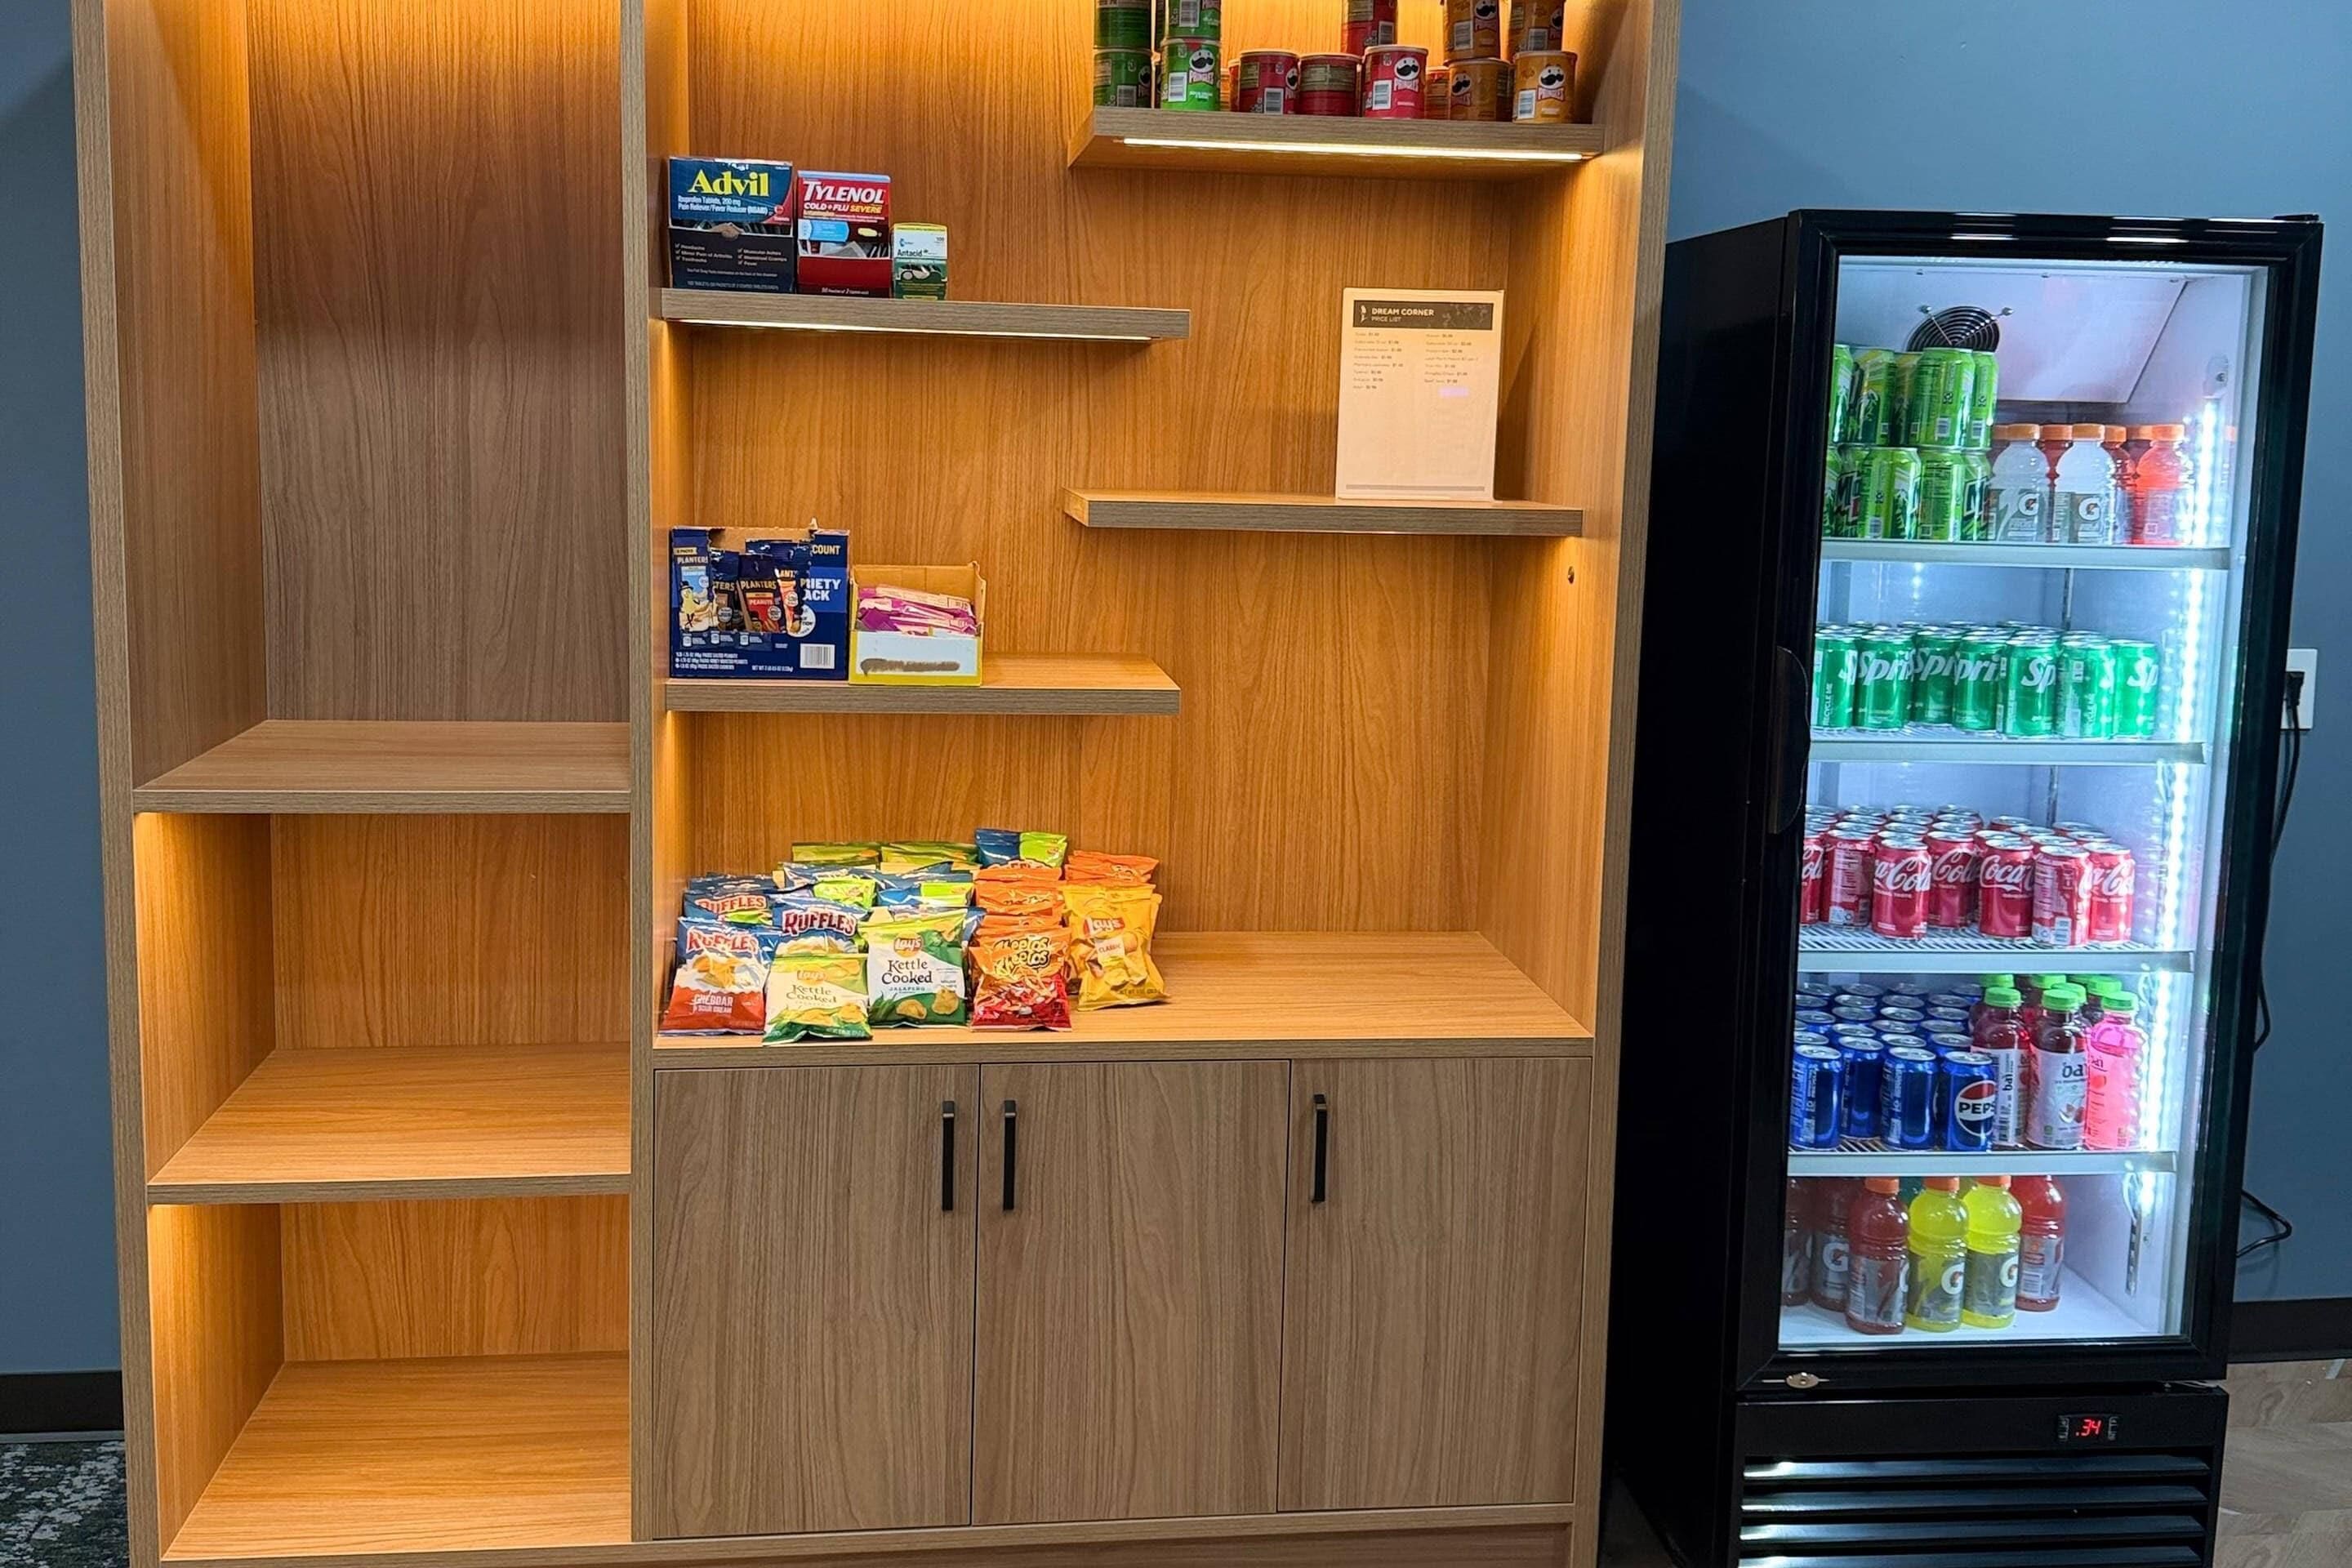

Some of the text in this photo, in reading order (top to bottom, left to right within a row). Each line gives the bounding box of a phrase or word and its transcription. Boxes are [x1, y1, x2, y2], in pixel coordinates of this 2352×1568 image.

[688, 169, 769, 197] Advil
[803, 180, 884, 203] TYLENOL
[850, 206, 882, 214] SEVERE
[898, 248, 922, 257] Antacid
[1401, 308, 1434, 317] CORNER
[2078, 497, 2101, 521] G
[812, 545, 840, 555] COUNT
[741, 581, 777, 590] PLANTERS
[802, 589, 831, 601] ACK
[783, 911, 857, 936] RUFFLES
[888, 958, 929, 973] Kettle
[882, 971, 933, 985] Cooked
[792, 985, 832, 996] Kettle
[786, 992, 837, 1004] Cooked
